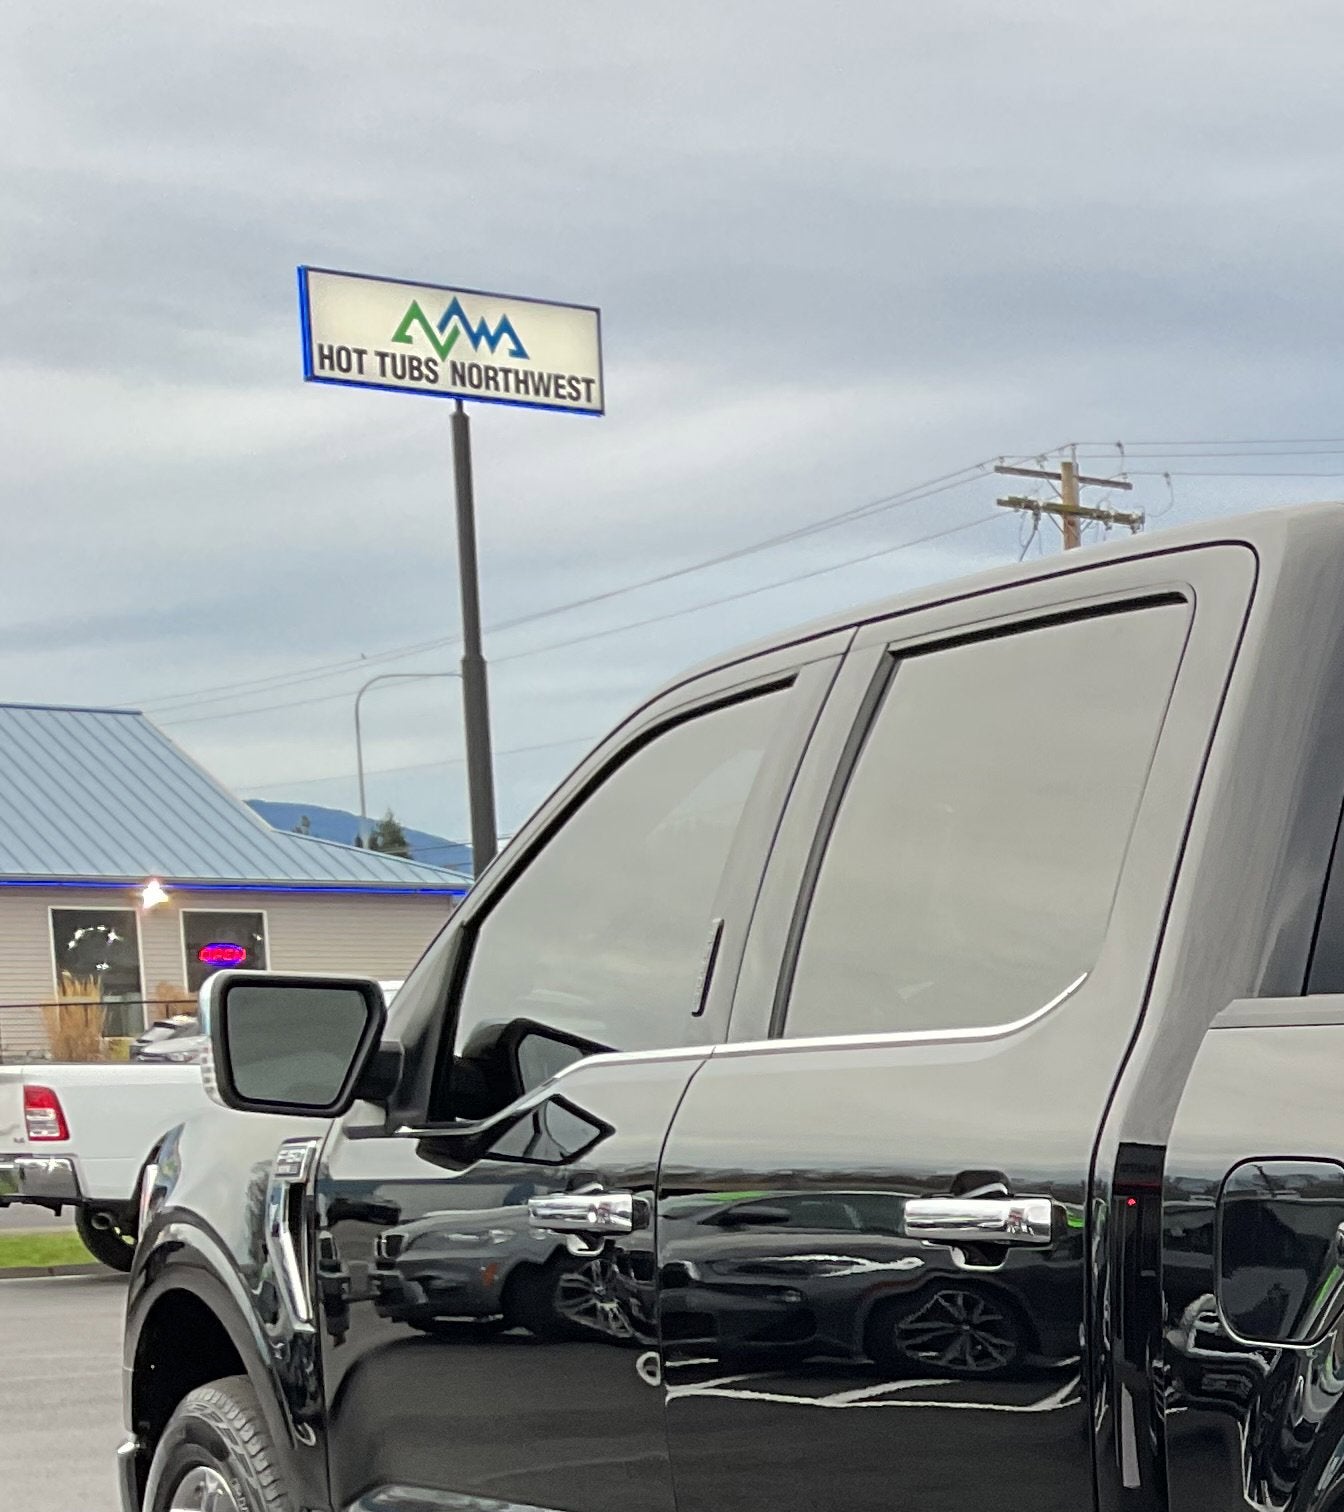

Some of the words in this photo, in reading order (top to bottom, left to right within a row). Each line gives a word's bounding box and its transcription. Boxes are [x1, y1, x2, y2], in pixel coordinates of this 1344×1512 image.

[317, 343, 367, 376] HOT
[374, 350, 439, 384] TUBS
[450, 360, 595, 403] NORTHWEST
